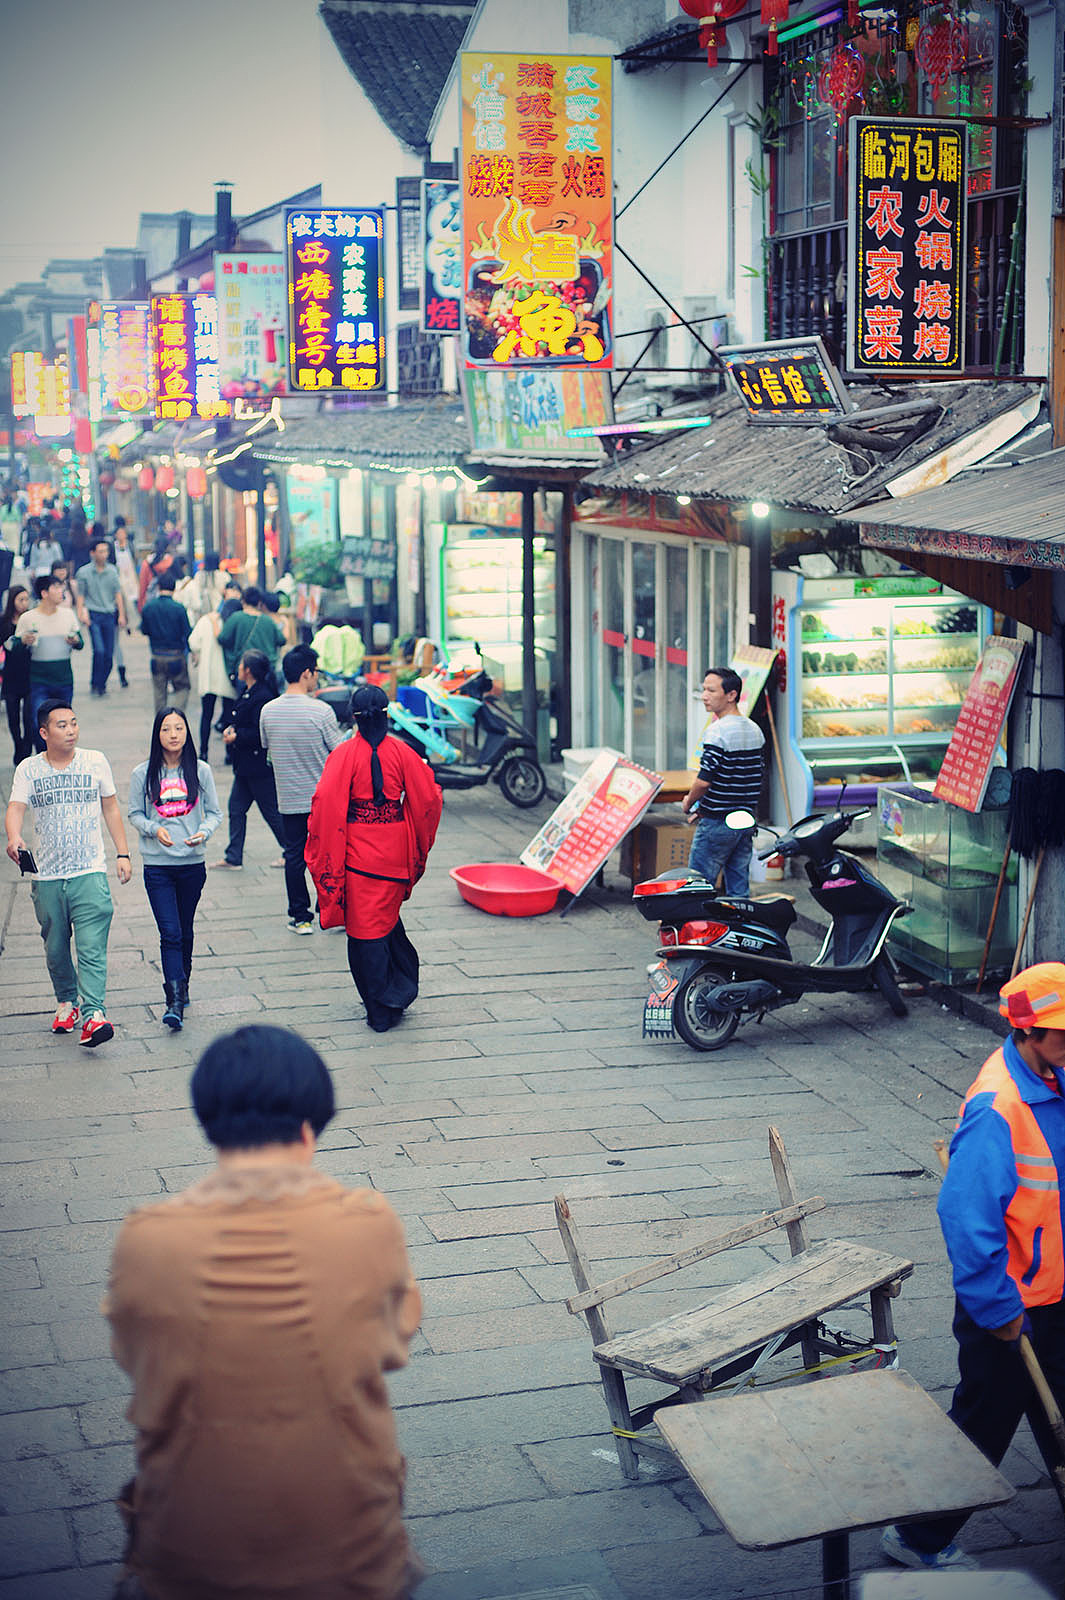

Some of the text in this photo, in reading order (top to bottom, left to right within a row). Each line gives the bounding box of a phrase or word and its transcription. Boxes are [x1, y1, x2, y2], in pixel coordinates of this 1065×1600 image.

[564, 64, 601, 153] 农家菜
[467, 154, 515, 199] 烧烤
[864, 131, 958, 183] 临河包厢
[295, 240, 335, 366] 西塘壹号
[864, 185, 905, 360] 农家菜
[913, 188, 953, 361] 火锅 烧烤
[158, 297, 195, 401] 诸葛烤鱼
[34, 775, 92, 793] ARMANI
